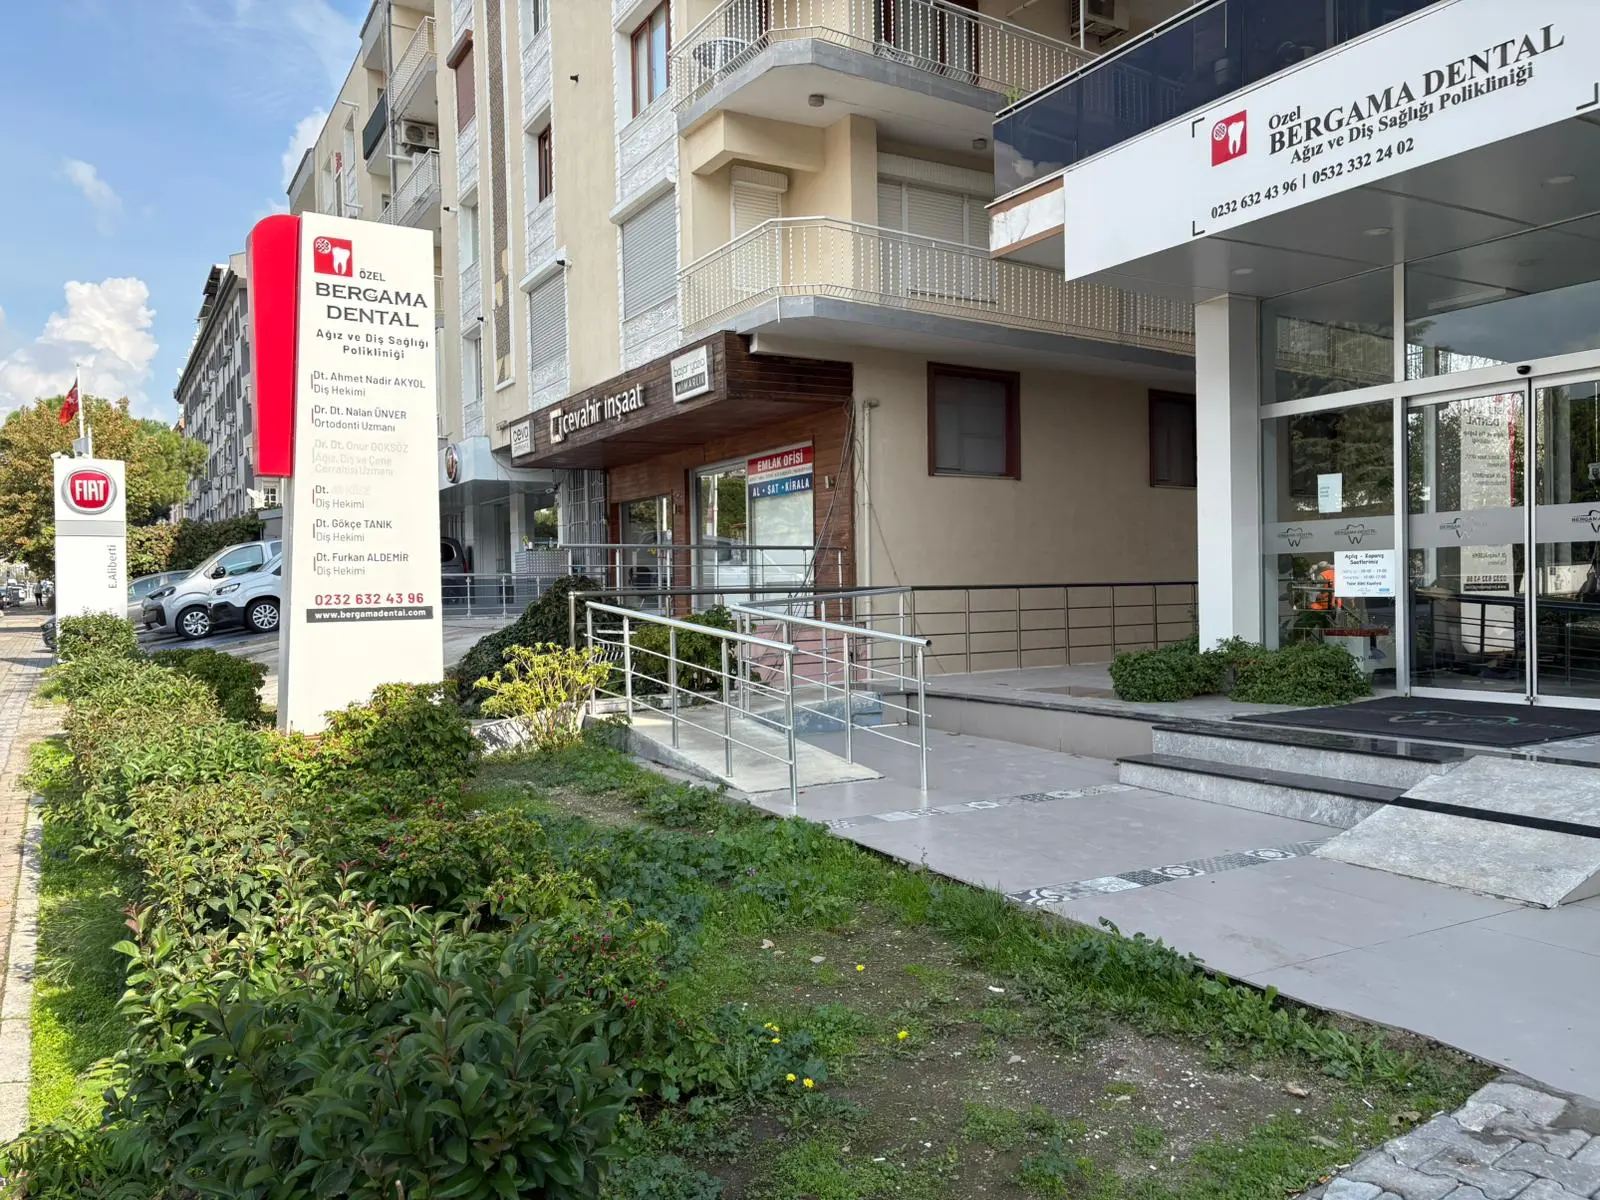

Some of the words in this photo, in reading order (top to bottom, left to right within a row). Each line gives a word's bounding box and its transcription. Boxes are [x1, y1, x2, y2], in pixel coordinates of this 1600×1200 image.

[1269, 80, 1416, 156] BERGAMA
[1422, 23, 1566, 98] DENTAL
[1290, 143, 1323, 164] Ağız
[1327, 135, 1344, 150] ve
[1349, 123, 1374, 143] Diş
[1378, 101, 1434, 132] Sağlığı
[1439, 61, 1534, 110] Polikliniği
[1211, 199, 1238, 219] 0232
[1240, 191, 1261, 209] 632
[1264, 184, 1279, 201] 43
[1282, 178, 1298, 196] 96
[1312, 162, 1344, 185] 0532
[1347, 152, 1372, 173] 332
[1376, 144, 1393, 163] 24
[1397, 137, 1414, 155] 02
[359, 268, 386, 281] ÖZEL
[315, 281, 428, 308] BERGAMA
[327, 304, 419, 327] DENTAL
[316, 328, 343, 341] Ağız
[347, 333, 361, 342] ve
[365, 333, 384, 345] Diş
[388, 335, 429, 350] Sağlığı
[343, 345, 405, 360] Polikliniği
[313, 370, 328, 380] Dt.
[330, 372, 363, 383] Ahmet
[365, 375, 392, 386] Nadir
[394, 377, 426, 389] AKYOL
[314, 384, 329, 395] Diş
[331, 385, 366, 397] Hekimi
[314, 404, 327, 415] Dr.
[330, 405, 344, 416] Dt.
[346, 407, 373, 417] Nalan
[374, 406, 407, 420] ÜNVER
[563, 398, 601, 434] cevahir
[314, 418, 360, 430] Ortodonti
[361, 421, 396, 432] Uzmanı
[757, 456, 782, 473] EMLAK
[783, 448, 804, 466] OFİSİ
[75, 479, 106, 501] FIAT
[315, 484, 329, 494] Dt.
[752, 486, 761, 497] AL
[785, 478, 810, 492] KİRALA
[315, 498, 331, 510] Diş
[332, 498, 365, 509] Hekimi
[316, 518, 330, 528] Dt.
[332, 518, 362, 531] Gökçe
[363, 519, 393, 529] TANIK
[316, 531, 331, 543] Diş
[333, 532, 365, 542] Hekimi
[316, 552, 330, 562] Dt.
[332, 552, 365, 562] Furkan
[367, 551, 409, 562] ALDEMİR
[107, 544, 117, 589] E.Aliberti
[316, 566, 331, 577] Diş
[333, 566, 366, 575] Hekimi
[315, 594, 351, 606] 0232
[355, 593, 381, 605] 632
[386, 592, 403, 604] 43
[407, 592, 424, 604] 96
[314, 609, 426, 620] www.bergamadental.com
